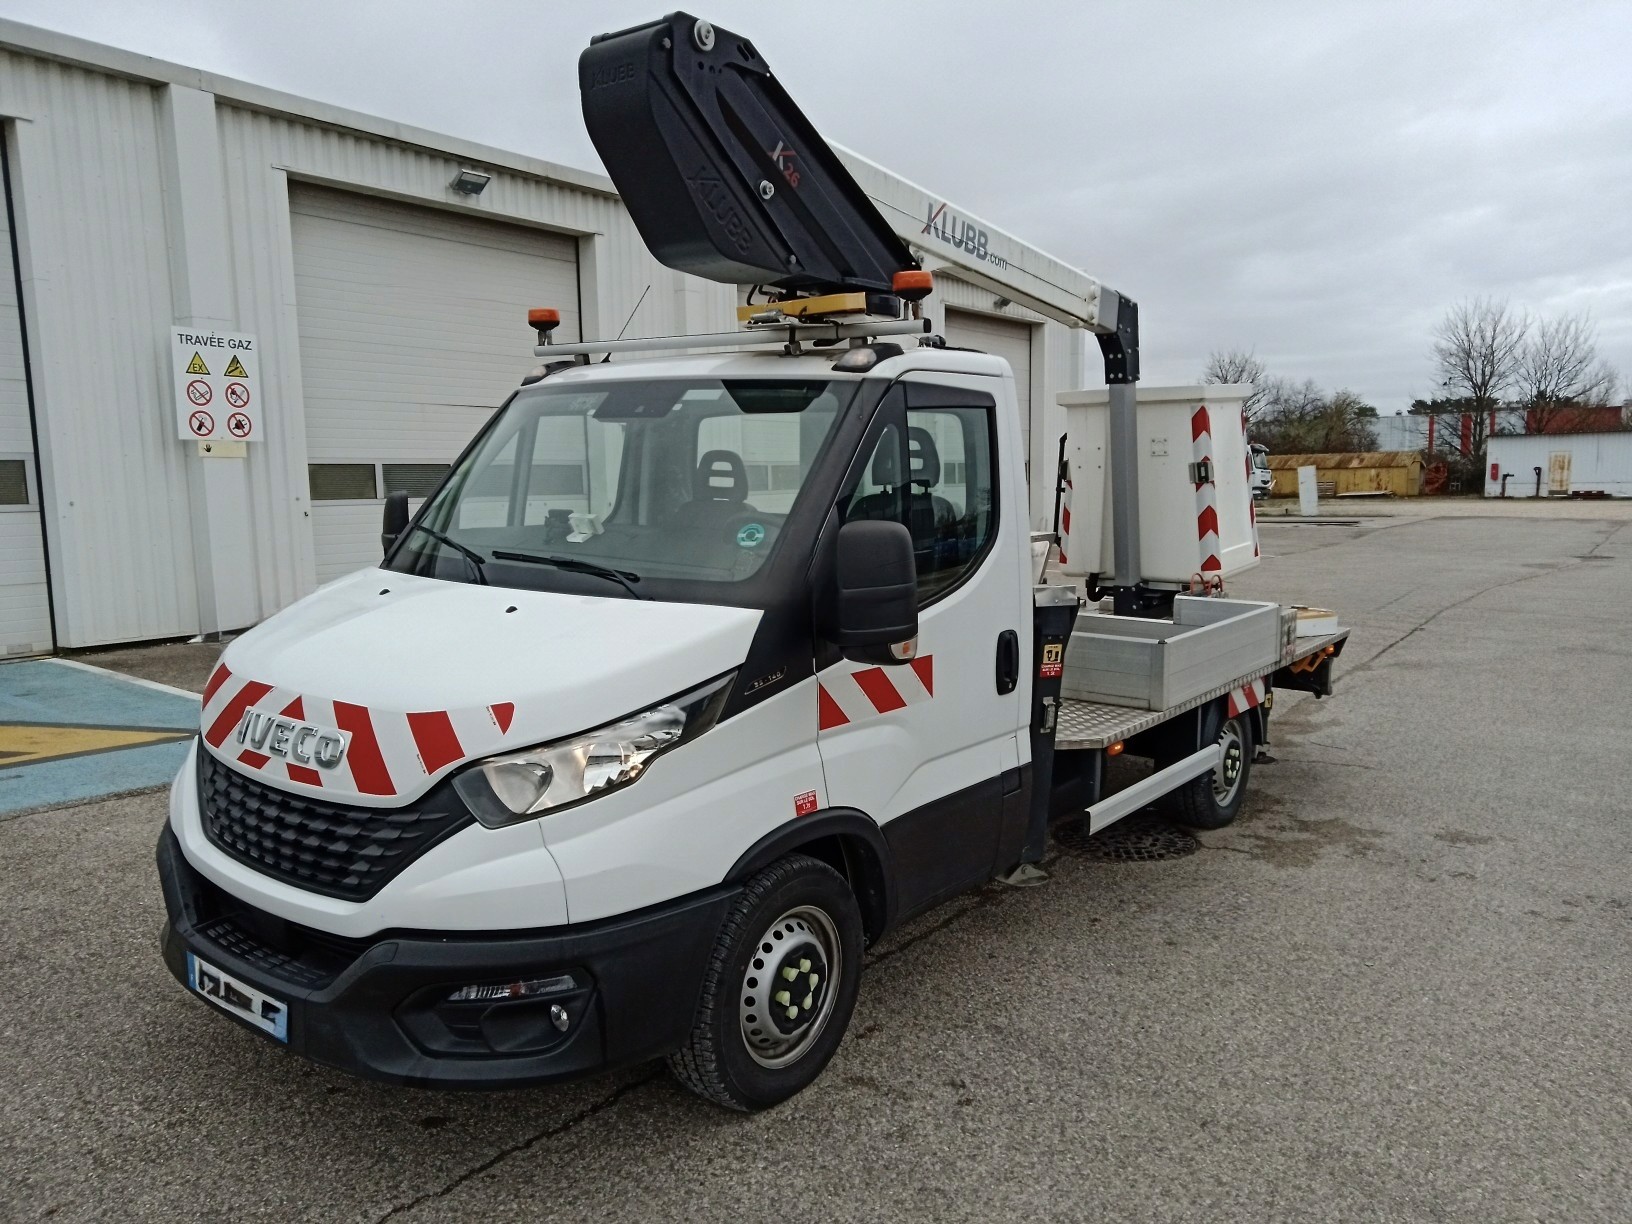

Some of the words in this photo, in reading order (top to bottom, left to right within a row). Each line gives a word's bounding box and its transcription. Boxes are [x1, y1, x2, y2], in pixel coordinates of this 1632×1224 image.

[177, 333, 225, 348] TRAVÉE
[227, 338, 253, 351] GAZ
[192, 362, 204, 373] EX
[236, 709, 346, 770] IVECO
